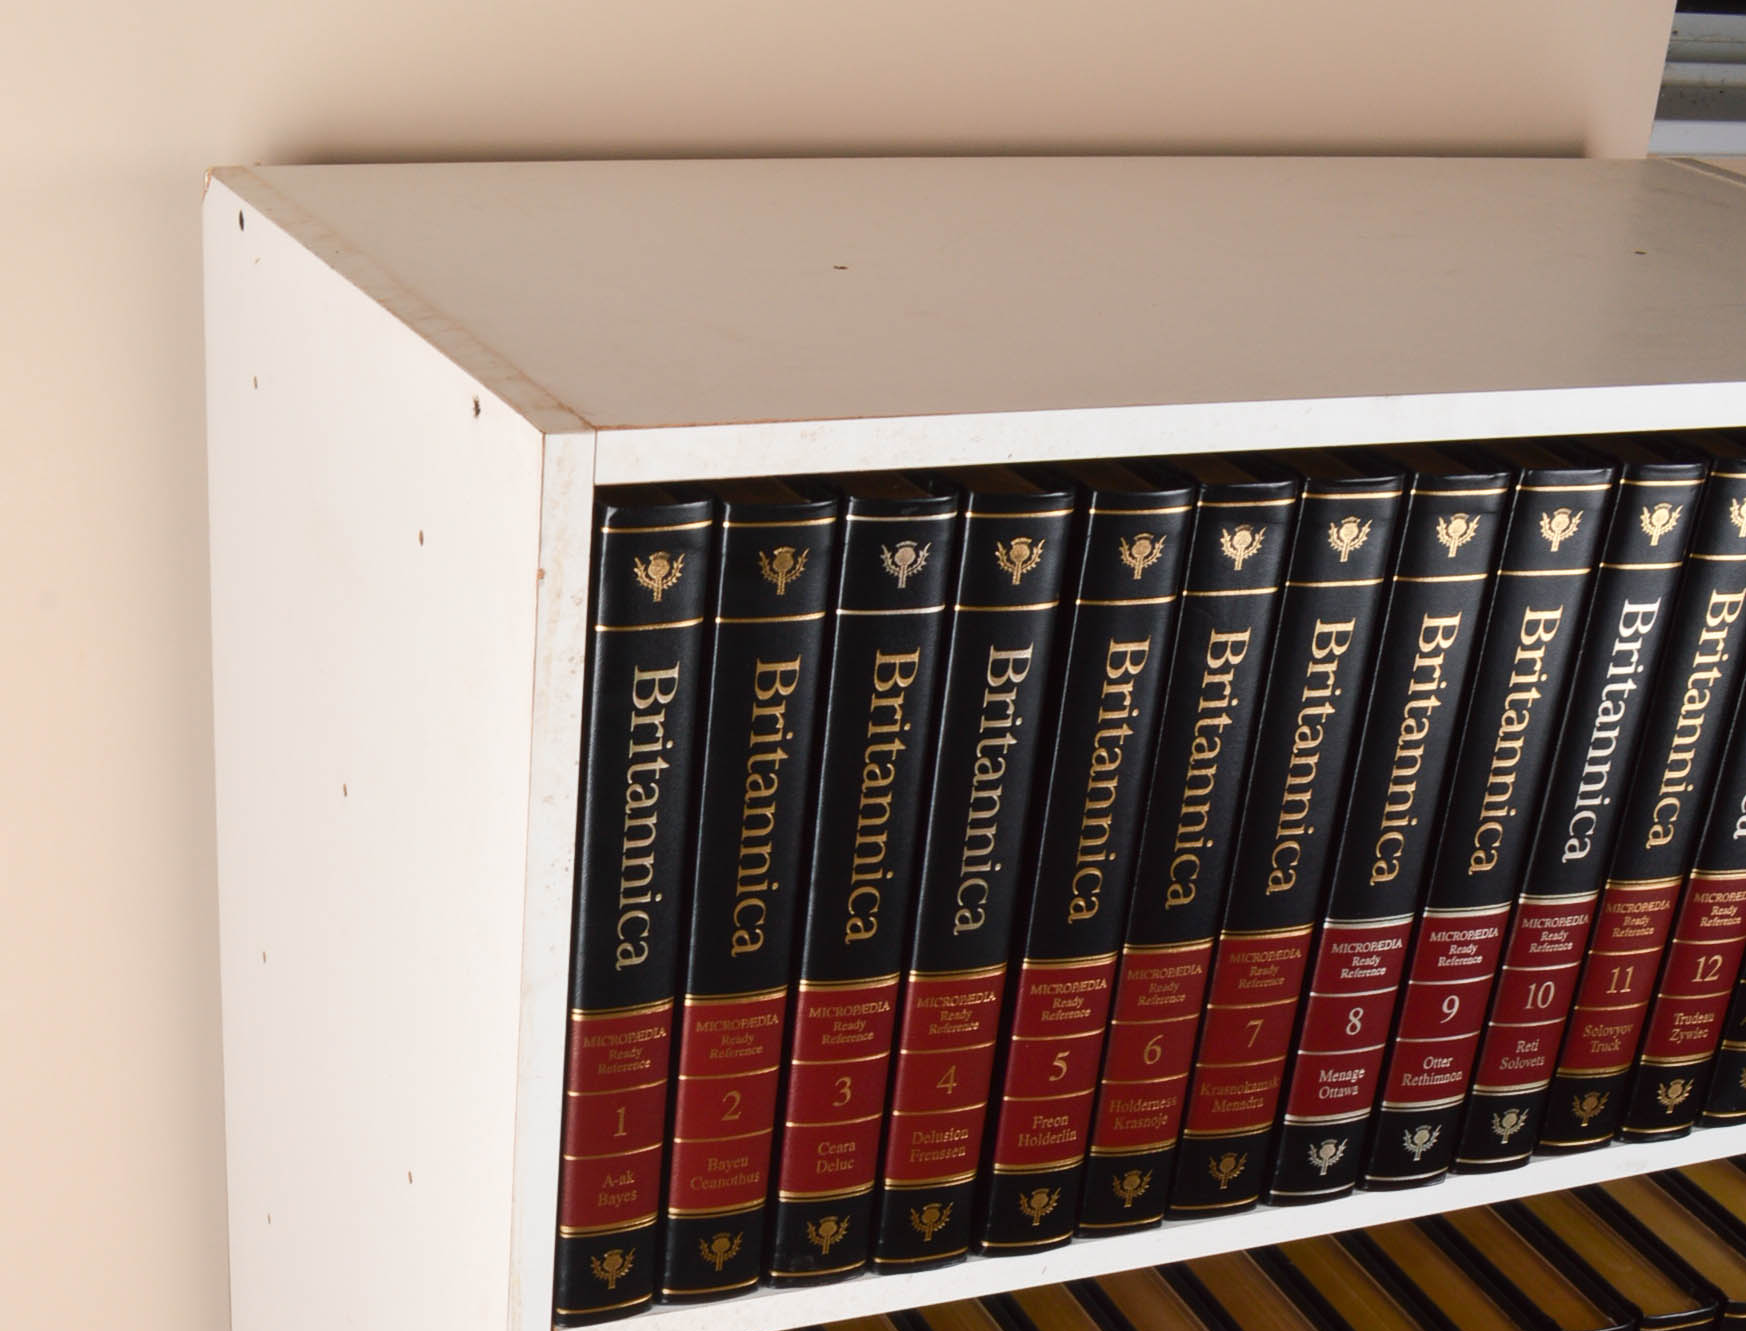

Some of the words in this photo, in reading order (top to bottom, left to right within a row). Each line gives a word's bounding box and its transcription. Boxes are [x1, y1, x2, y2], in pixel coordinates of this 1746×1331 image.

[1644, 586, 1746, 850] Britannica
[1562, 597, 1661, 864] Britannica
[1468, 603, 1563, 876] Britannica
[1370, 610, 1461, 886] Britannica
[1266, 617, 1356, 897] Britannica
[1164, 626, 1252, 910] Britannica
[1067, 635, 1151, 924] Britannica
[844, 647, 921, 945] Britannica
[954, 641, 1034, 936] Britannica
[731, 651, 801, 958] Britannica
[615, 660, 679, 972] Britannica
[1711, 906, 1738, 917] Ready
[1623, 916, 1651, 927] Ready
[1700, 916, 1742, 928] Reference
[1540, 930, 1569, 942] Ready
[1613, 926, 1655, 938] Reference
[1448, 944, 1479, 956] Ready
[1529, 941, 1574, 953] Reference
[1352, 956, 1382, 967] Ready
[1438, 954, 1483, 967] Reference
[1250, 965, 1280, 977] Ready
[1340, 966, 1387, 980] Reference
[1691, 955, 1723, 983] 12
[1148, 981, 1180, 993] Ready
[1237, 977, 1286, 989] Reference
[1606, 966, 1636, 995] 11
[1052, 998, 1084, 1009] Ready
[1137, 993, 1186, 1007] Reference
[1525, 981, 1556, 1010] 10
[940, 1008, 973, 1021] Ready
[1040, 1008, 1091, 1021] Reference
[1440, 995, 1460, 1024] 9
[833, 1019, 867, 1032] Ready
[1345, 1007, 1364, 1036] 8
[1673, 1012, 1715, 1026] Trudeau
[928, 1021, 980, 1035] Reference
[1246, 1019, 1264, 1048] 7
[721, 1032, 755, 1047] Ready
[821, 1031, 875, 1045] Reference
[608, 1047, 642, 1061] Ready
[709, 1044, 764, 1060] Reference
[1143, 1034, 1164, 1065] 6
[1591, 1040, 1623, 1053] Truck
[597, 1059, 651, 1075] Reference
[1048, 1050, 1070, 1081] 5
[1423, 1056, 1454, 1070] Otter
[936, 1064, 958, 1095] 4
[1320, 1067, 1366, 1083] Menage
[832, 1076, 852, 1107] 3
[1318, 1084, 1360, 1100] Ottawa
[720, 1090, 742, 1120] 2
[1109, 1096, 1177, 1113] Holderness
[613, 1106, 627, 1137] 1
[1032, 1115, 1070, 1129] Freon
[912, 1127, 969, 1145] Delusion
